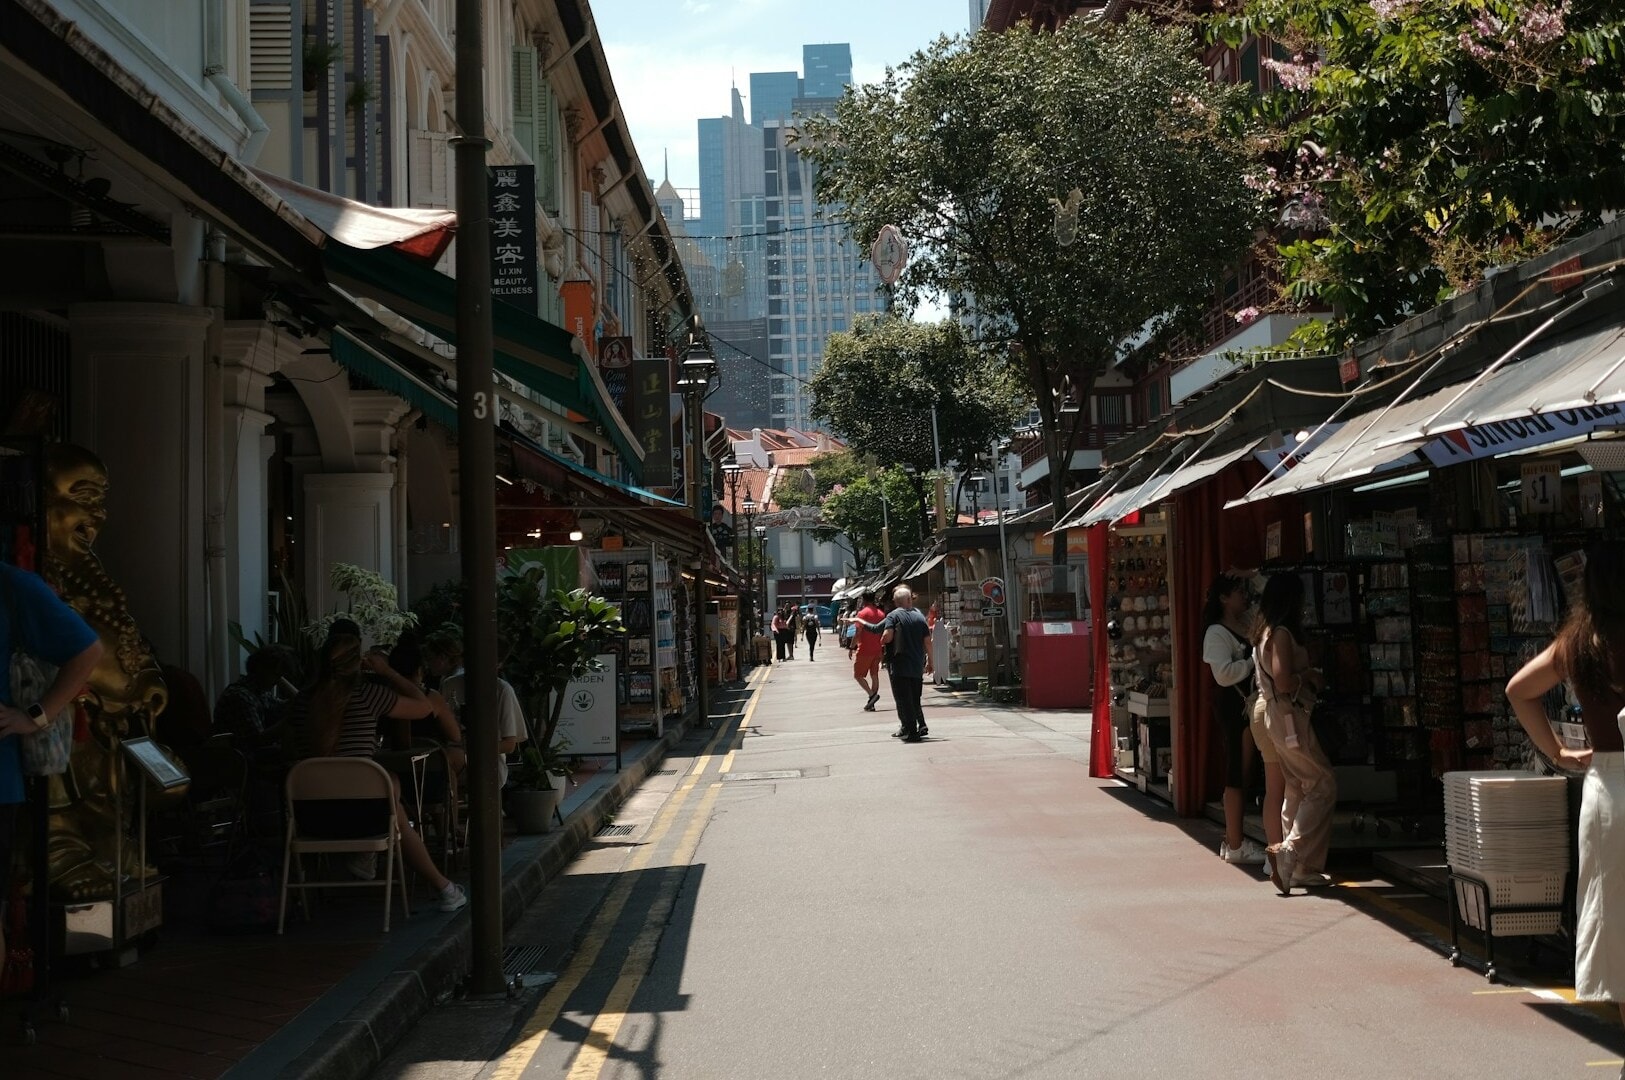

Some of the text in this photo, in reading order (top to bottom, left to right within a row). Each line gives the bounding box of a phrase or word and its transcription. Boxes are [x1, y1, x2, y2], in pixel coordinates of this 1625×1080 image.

[493, 169, 525, 265] 麗鑫美容
[499, 268, 507, 276] LI
[494, 278, 527, 286] BEAUTY
[474, 391, 486, 419] 3
